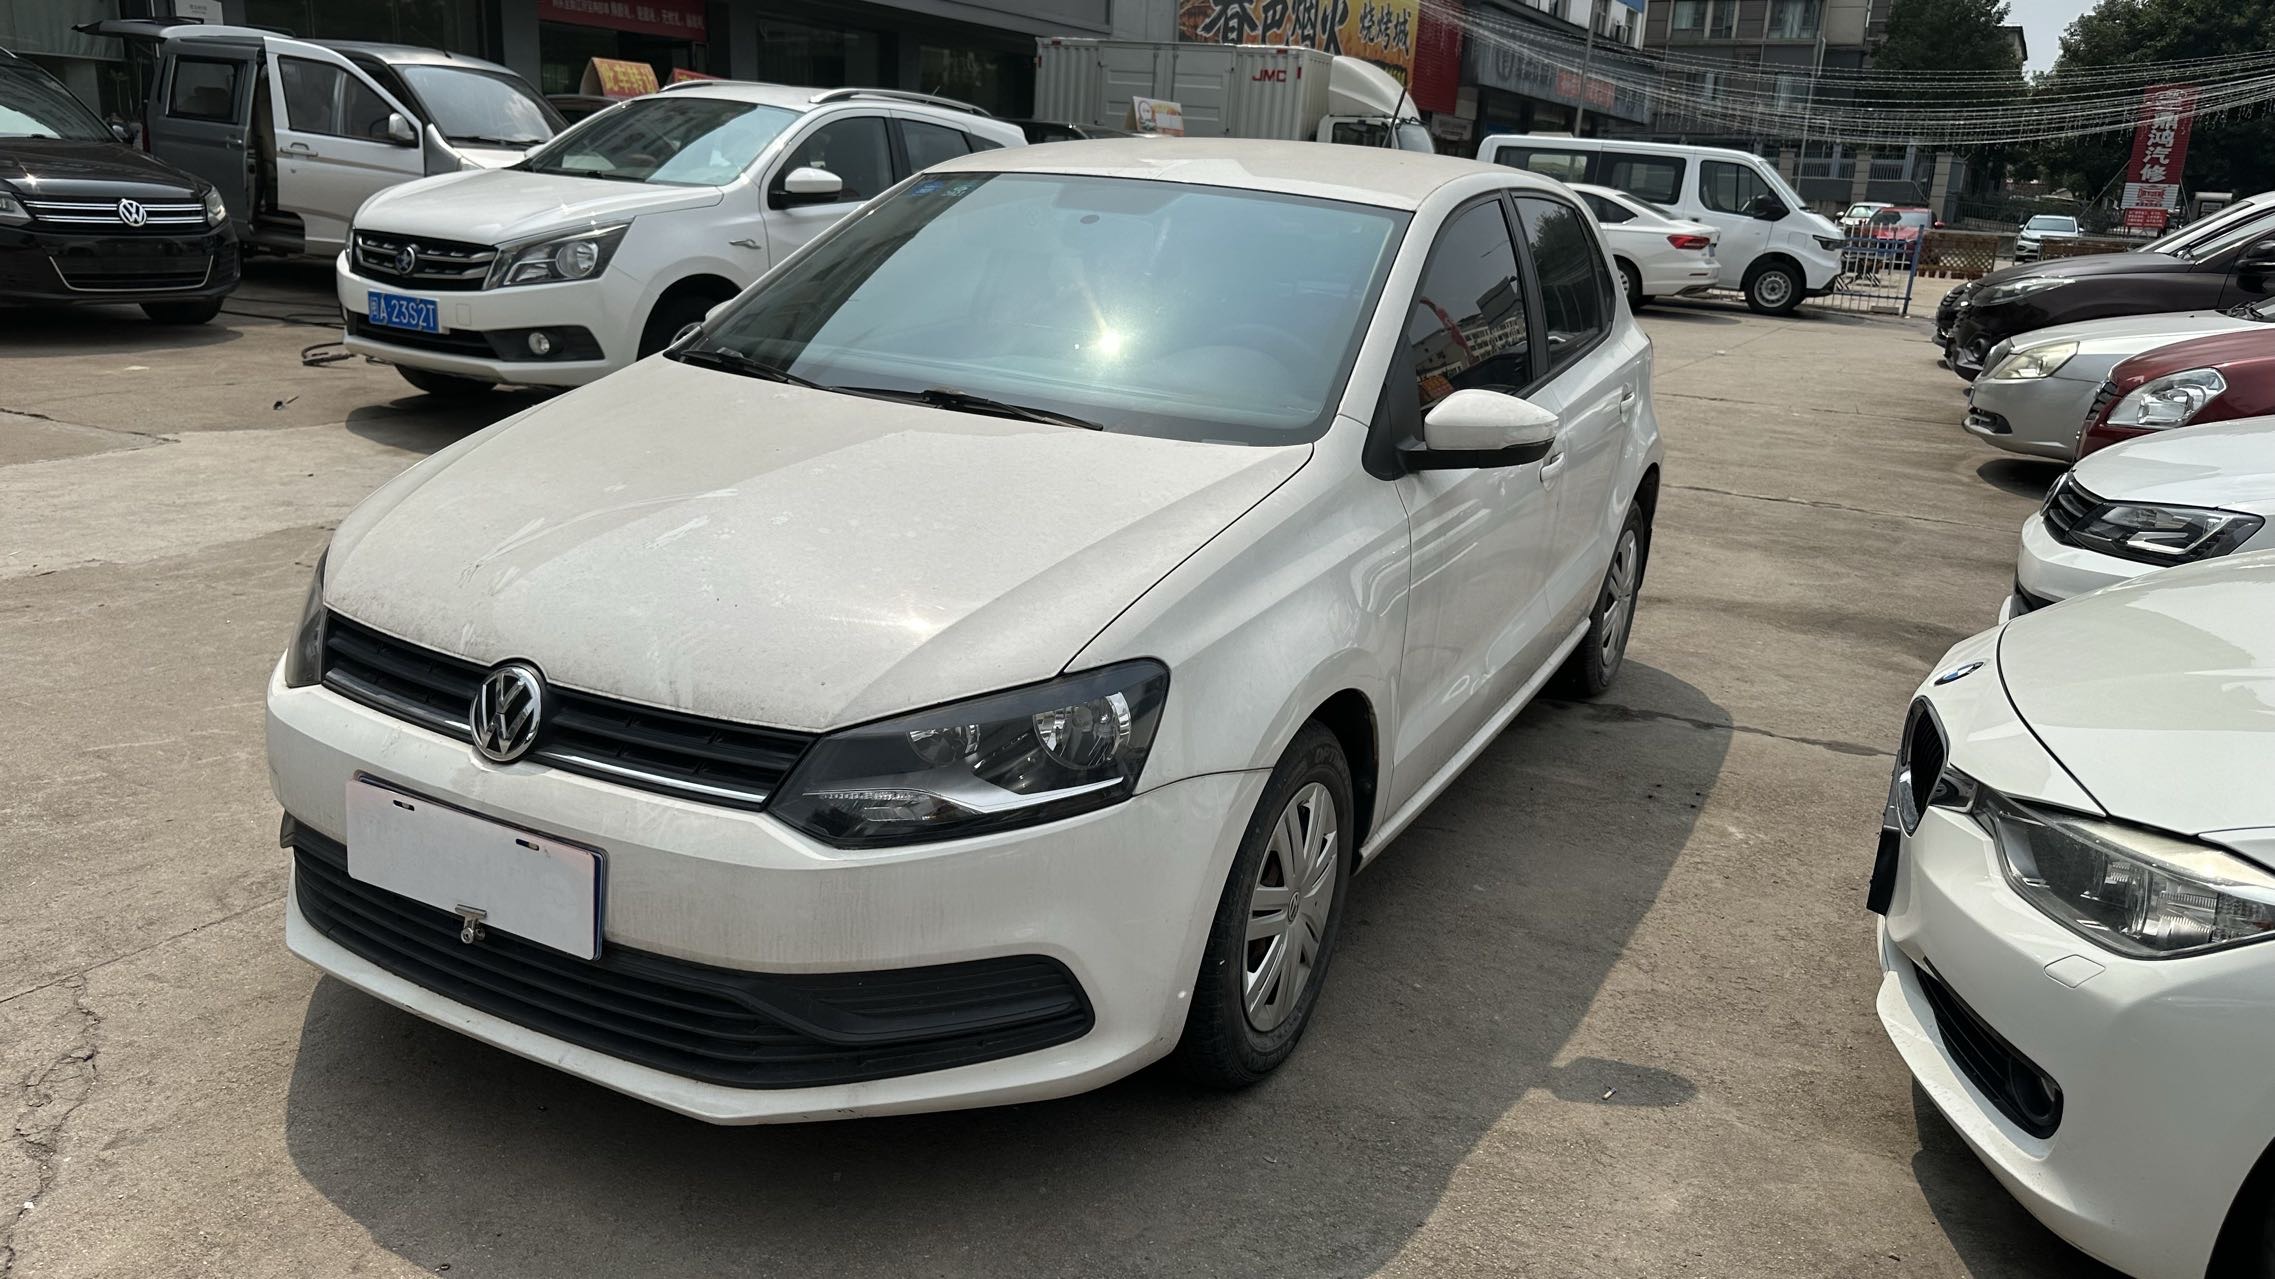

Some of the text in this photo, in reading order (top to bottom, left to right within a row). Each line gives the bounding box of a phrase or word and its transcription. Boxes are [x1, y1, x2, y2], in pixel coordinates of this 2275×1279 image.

[1359, 0, 1411, 57] 烧烤城
[1252, 69, 1287, 82] JMC
